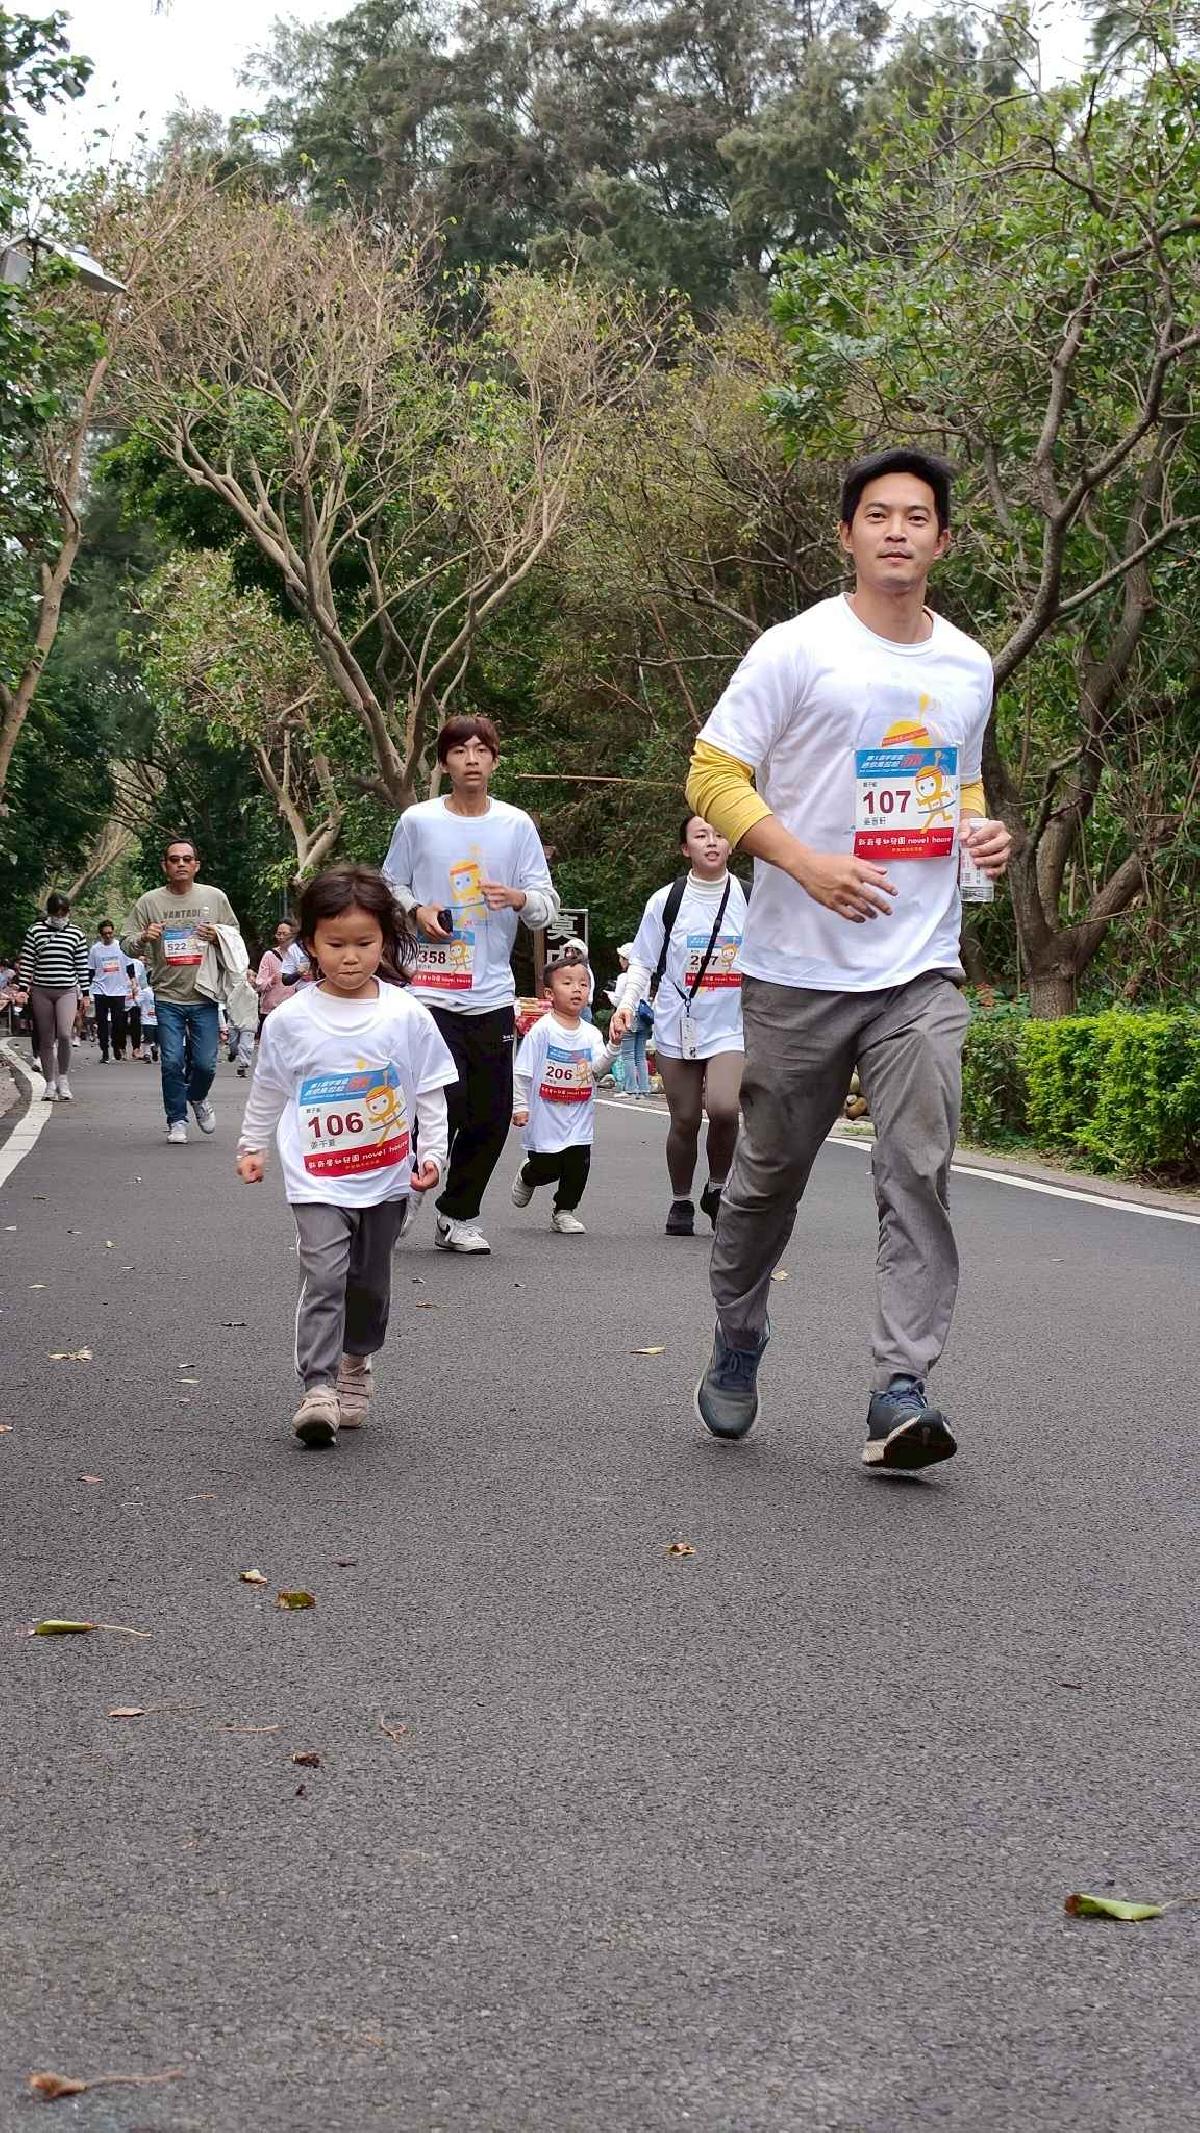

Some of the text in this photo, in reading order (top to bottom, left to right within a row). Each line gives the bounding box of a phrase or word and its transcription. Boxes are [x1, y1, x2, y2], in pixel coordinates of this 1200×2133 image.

[863, 790, 911, 814] 107
[907, 836, 929, 844] novel
[167, 942, 187, 951] 522
[418, 950, 446, 964] 358
[546, 1065, 573, 1081] 206
[308, 1112, 364, 1138] 106
[362, 1148, 386, 1161] novel
